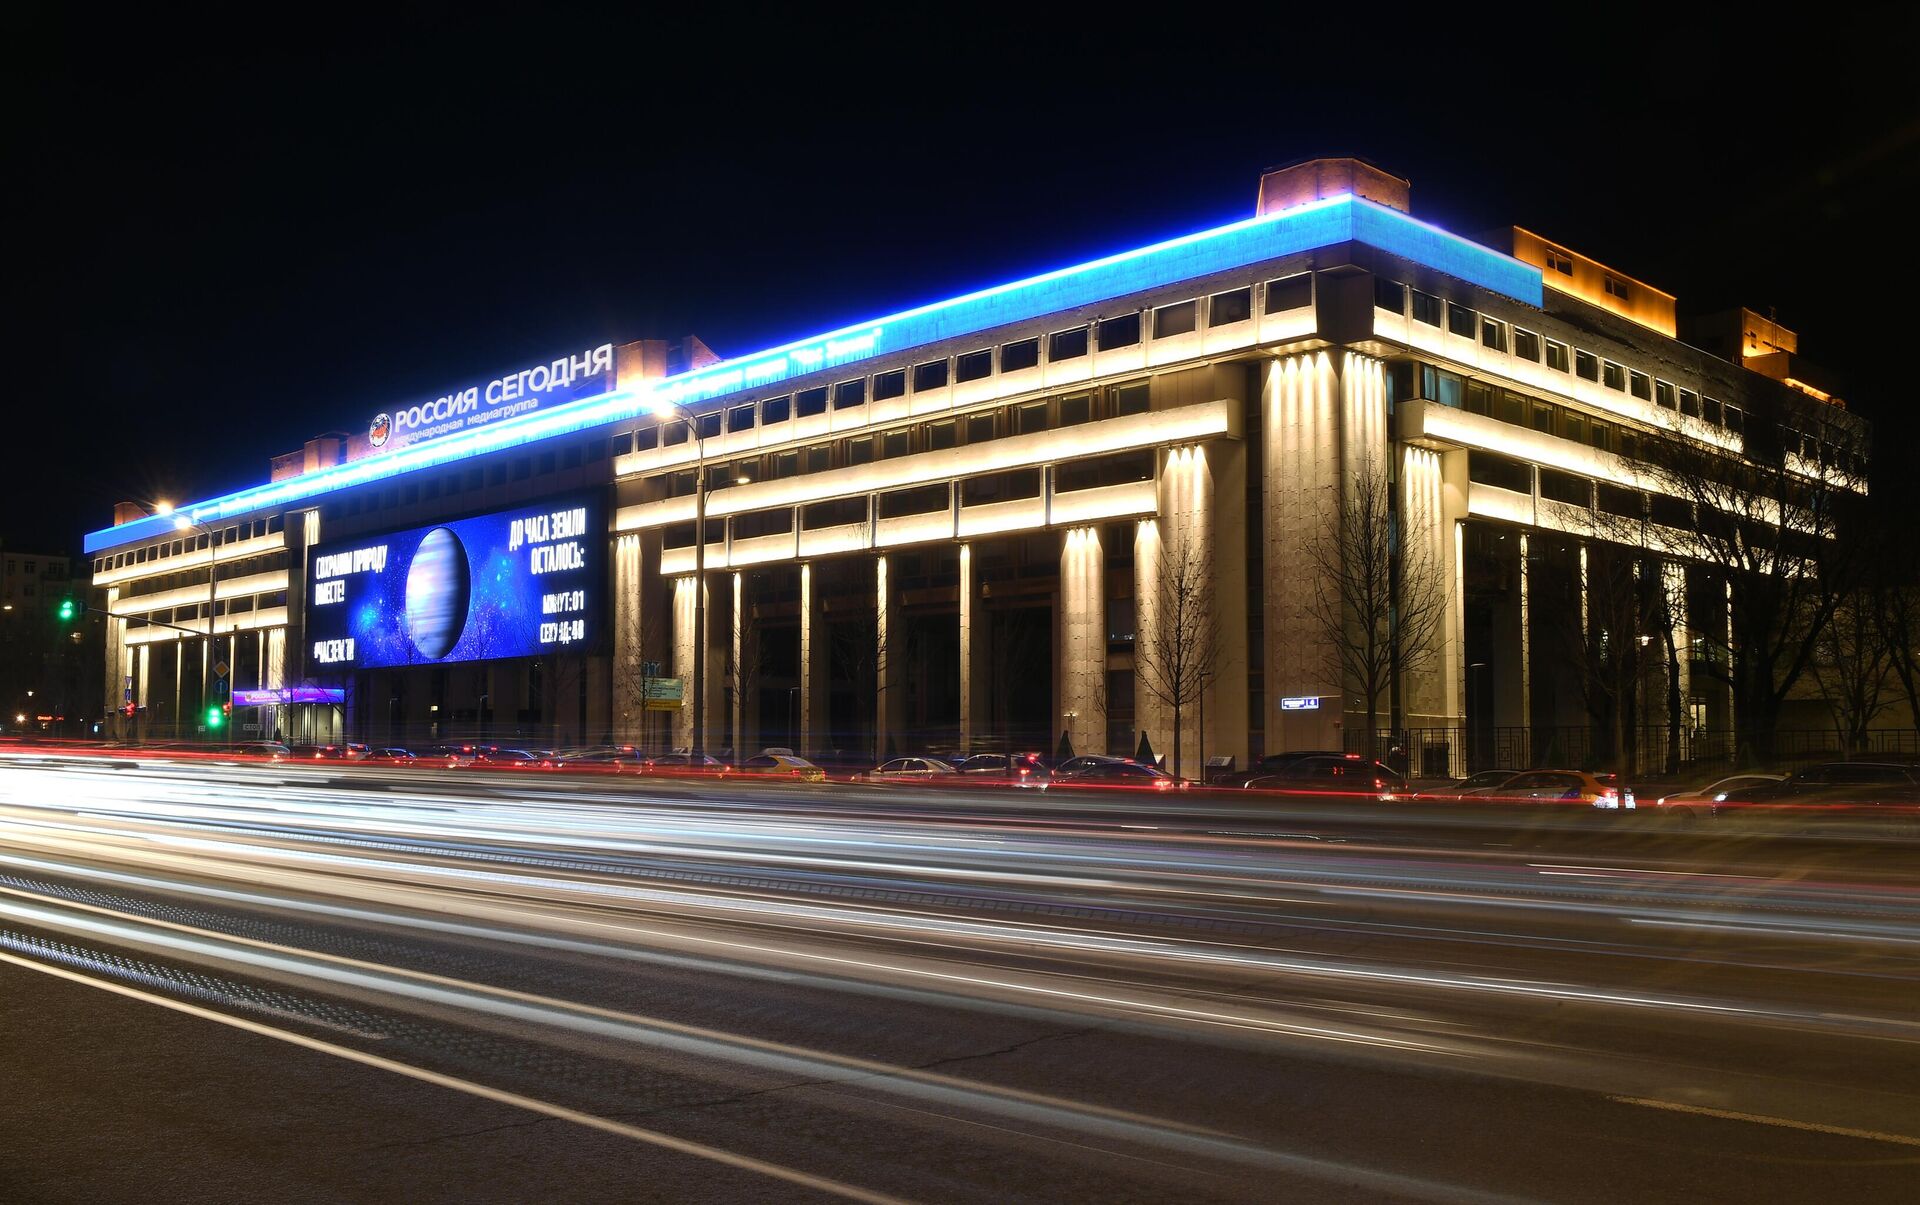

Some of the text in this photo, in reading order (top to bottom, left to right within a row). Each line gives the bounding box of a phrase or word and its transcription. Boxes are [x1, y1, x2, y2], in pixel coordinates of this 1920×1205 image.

[394, 387, 478, 433] РОССИЯ
[485, 342, 613, 405] СЕГОДНЯ
[394, 398, 539, 444] ждународная медиагруппа
[509, 507, 586, 552] ДО ЧАСА ЗЕМЛИ
[353, 544, 388, 574] ПРИРОДУ
[531, 541, 585, 575] ОСТАЛОСЬ:
[315, 579, 345, 606] ВМЕСТЕ!
